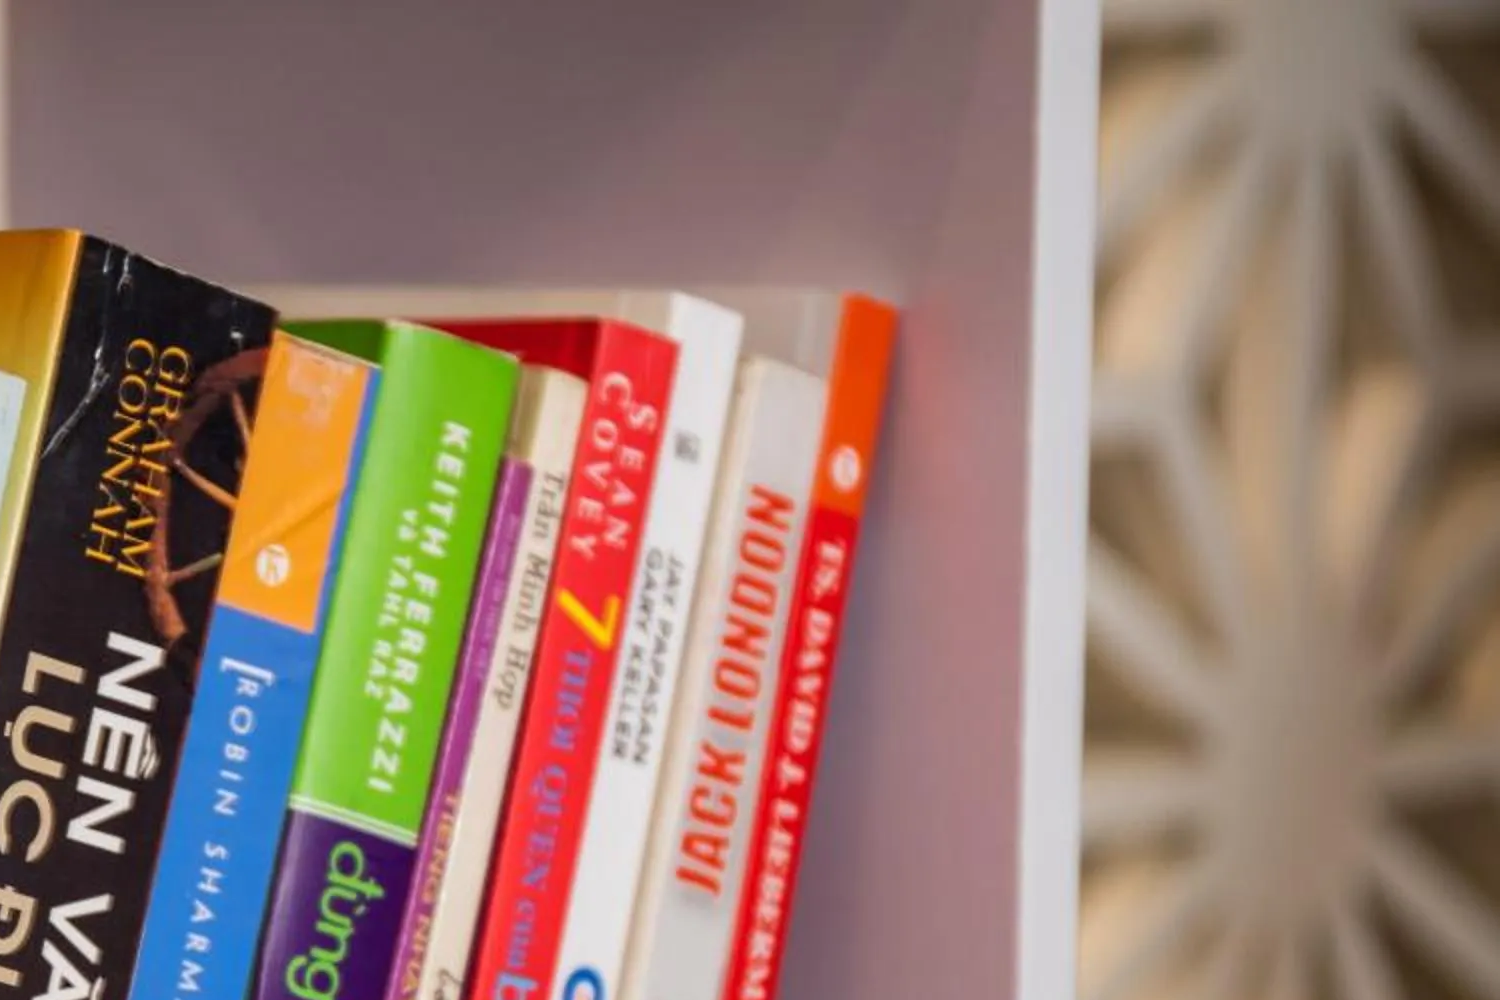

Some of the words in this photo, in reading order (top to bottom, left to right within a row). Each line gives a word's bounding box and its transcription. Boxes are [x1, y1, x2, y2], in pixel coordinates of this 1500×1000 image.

[85, 338, 156, 564] CONNAH
[116, 346, 191, 578] GRAHAM
[419, 421, 473, 558] KEITH
[570, 371, 633, 560] COVEY
[604, 402, 658, 550] SEAN
[377, 554, 412, 628] TAHL
[514, 556, 547, 636] Minh
[556, 588, 620, 650] 7
[707, 485, 797, 732] LONDON
[368, 570, 439, 794] FERRAZZI
[611, 640, 646, 760] KELLER
[786, 606, 835, 755] DAVID
[522, 768, 569, 890] QUEN
[675, 741, 748, 898] JACK
